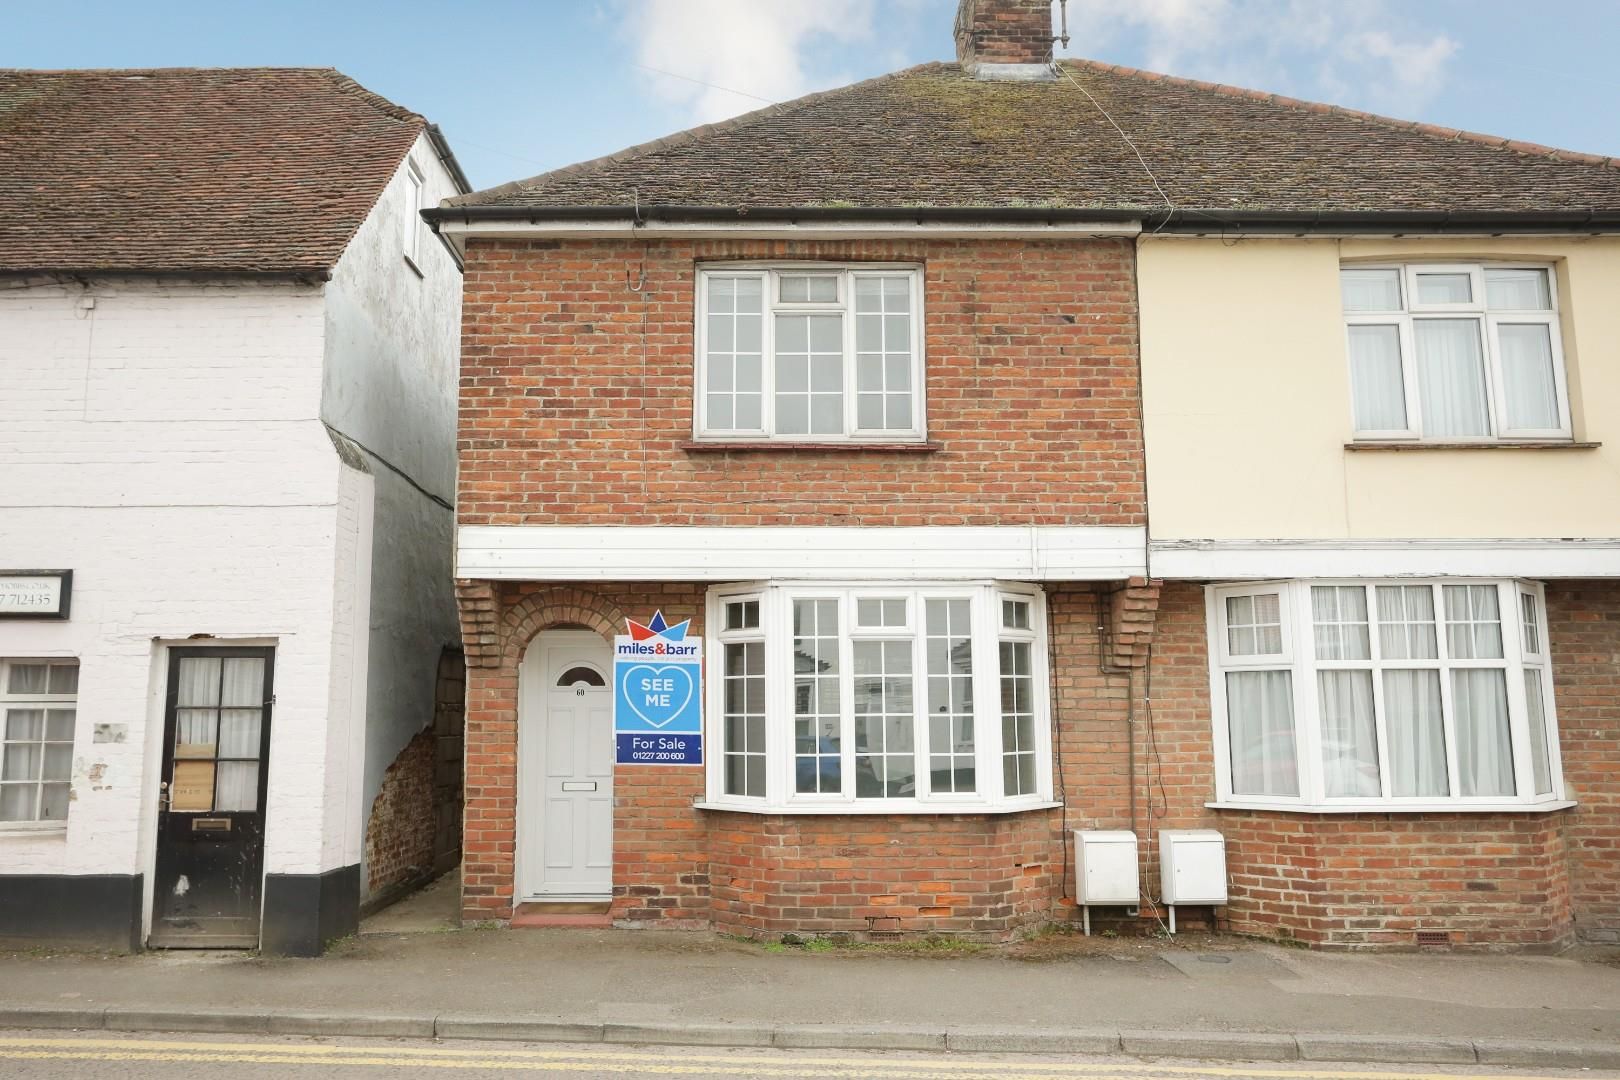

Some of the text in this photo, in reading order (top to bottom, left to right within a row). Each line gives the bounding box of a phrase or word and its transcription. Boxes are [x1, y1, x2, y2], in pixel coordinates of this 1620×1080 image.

[9, 594, 51, 605] 712435
[618, 643, 697, 655] miles&barr
[641, 678, 674, 691] SEE
[576, 689, 585, 697] 60
[645, 694, 671, 707] ME
[632, 737, 686, 750] For Sale
[655, 752, 670, 760] 200
[670, 752, 685, 760] 600
